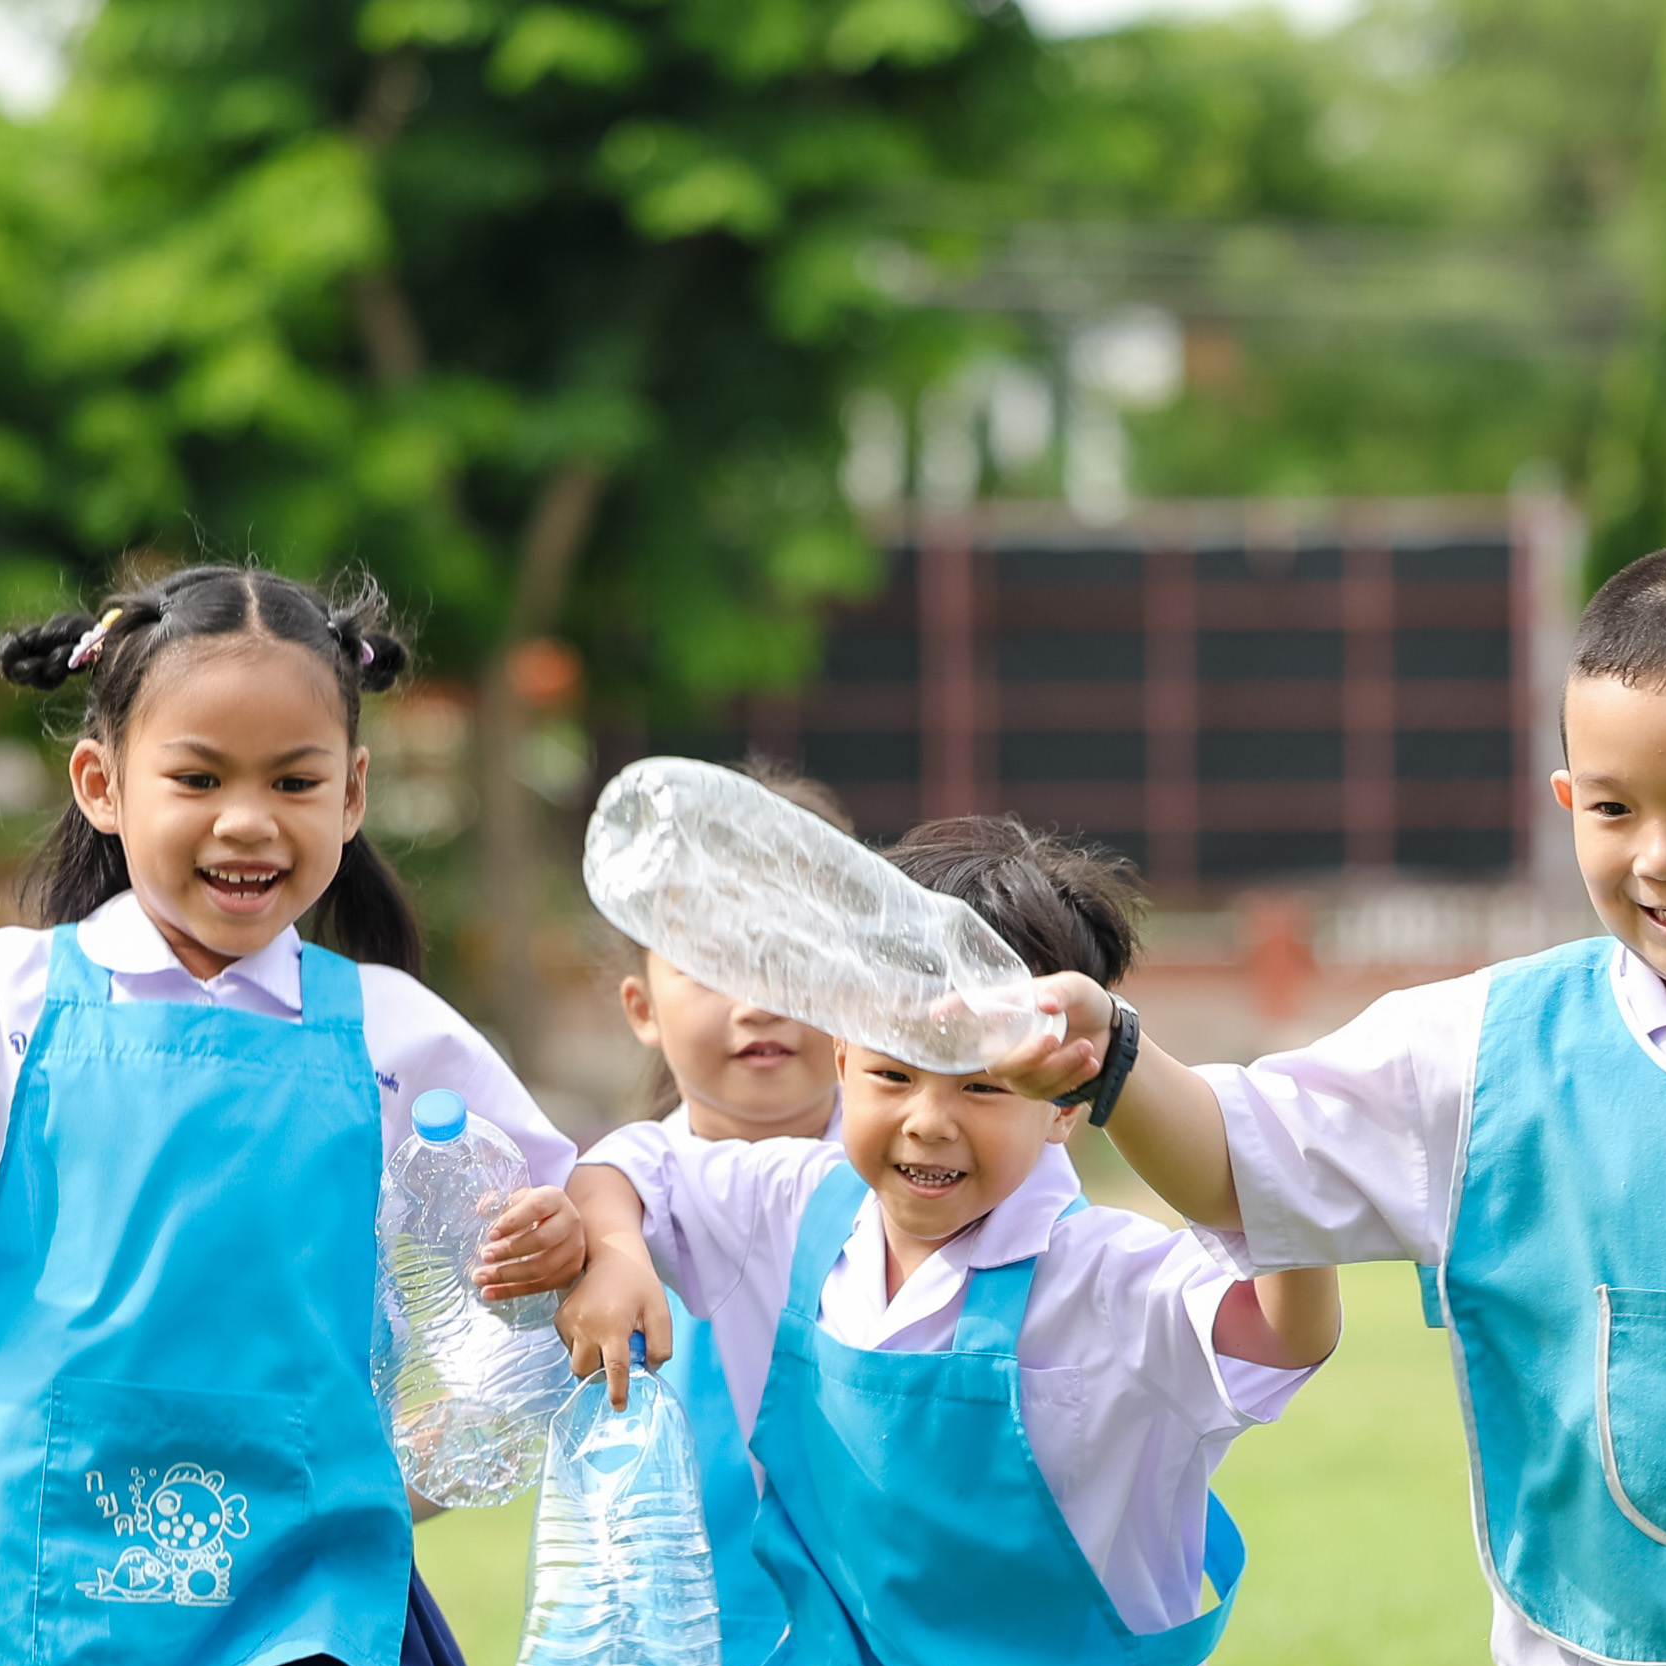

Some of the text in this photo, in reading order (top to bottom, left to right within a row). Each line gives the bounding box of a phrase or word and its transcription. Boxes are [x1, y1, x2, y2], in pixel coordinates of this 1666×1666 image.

[85, 1470, 136, 1537] ก ข ค
